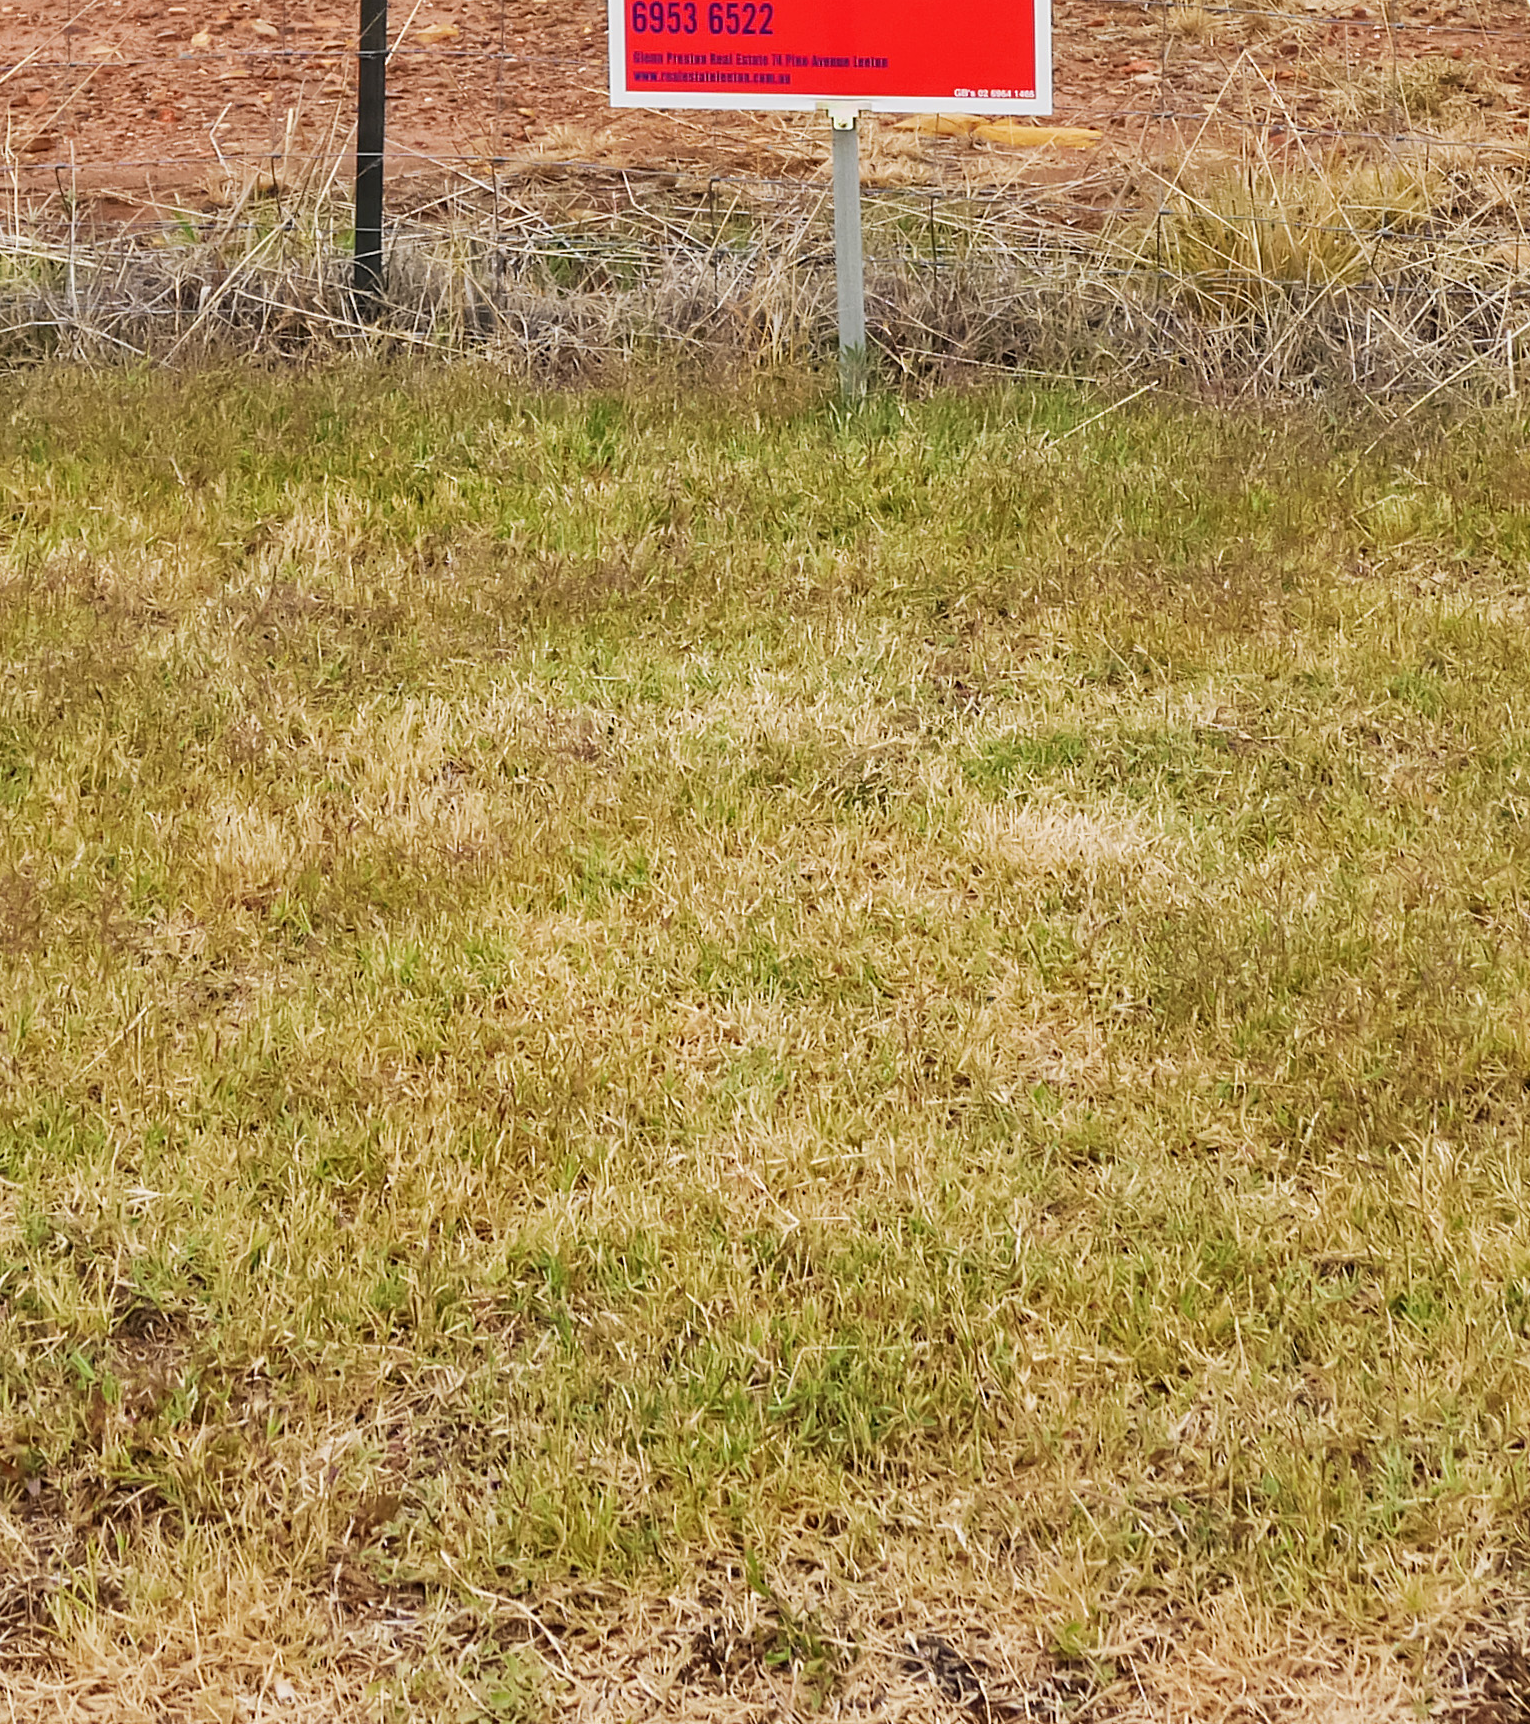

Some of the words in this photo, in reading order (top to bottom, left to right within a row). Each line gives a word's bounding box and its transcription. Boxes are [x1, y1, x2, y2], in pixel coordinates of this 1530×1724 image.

[632, 1, 697, 34] 6953
[708, 2, 774, 35] 6522
[633, 51, 663, 63] Glenn
[667, 52, 706, 64] Preston
[710, 53, 733, 65] Real
[736, 53, 768, 66] Estate
[785, 54, 808, 67] Pine
[812, 55, 850, 68] Avenue
[853, 56, 888, 68] Leeton
